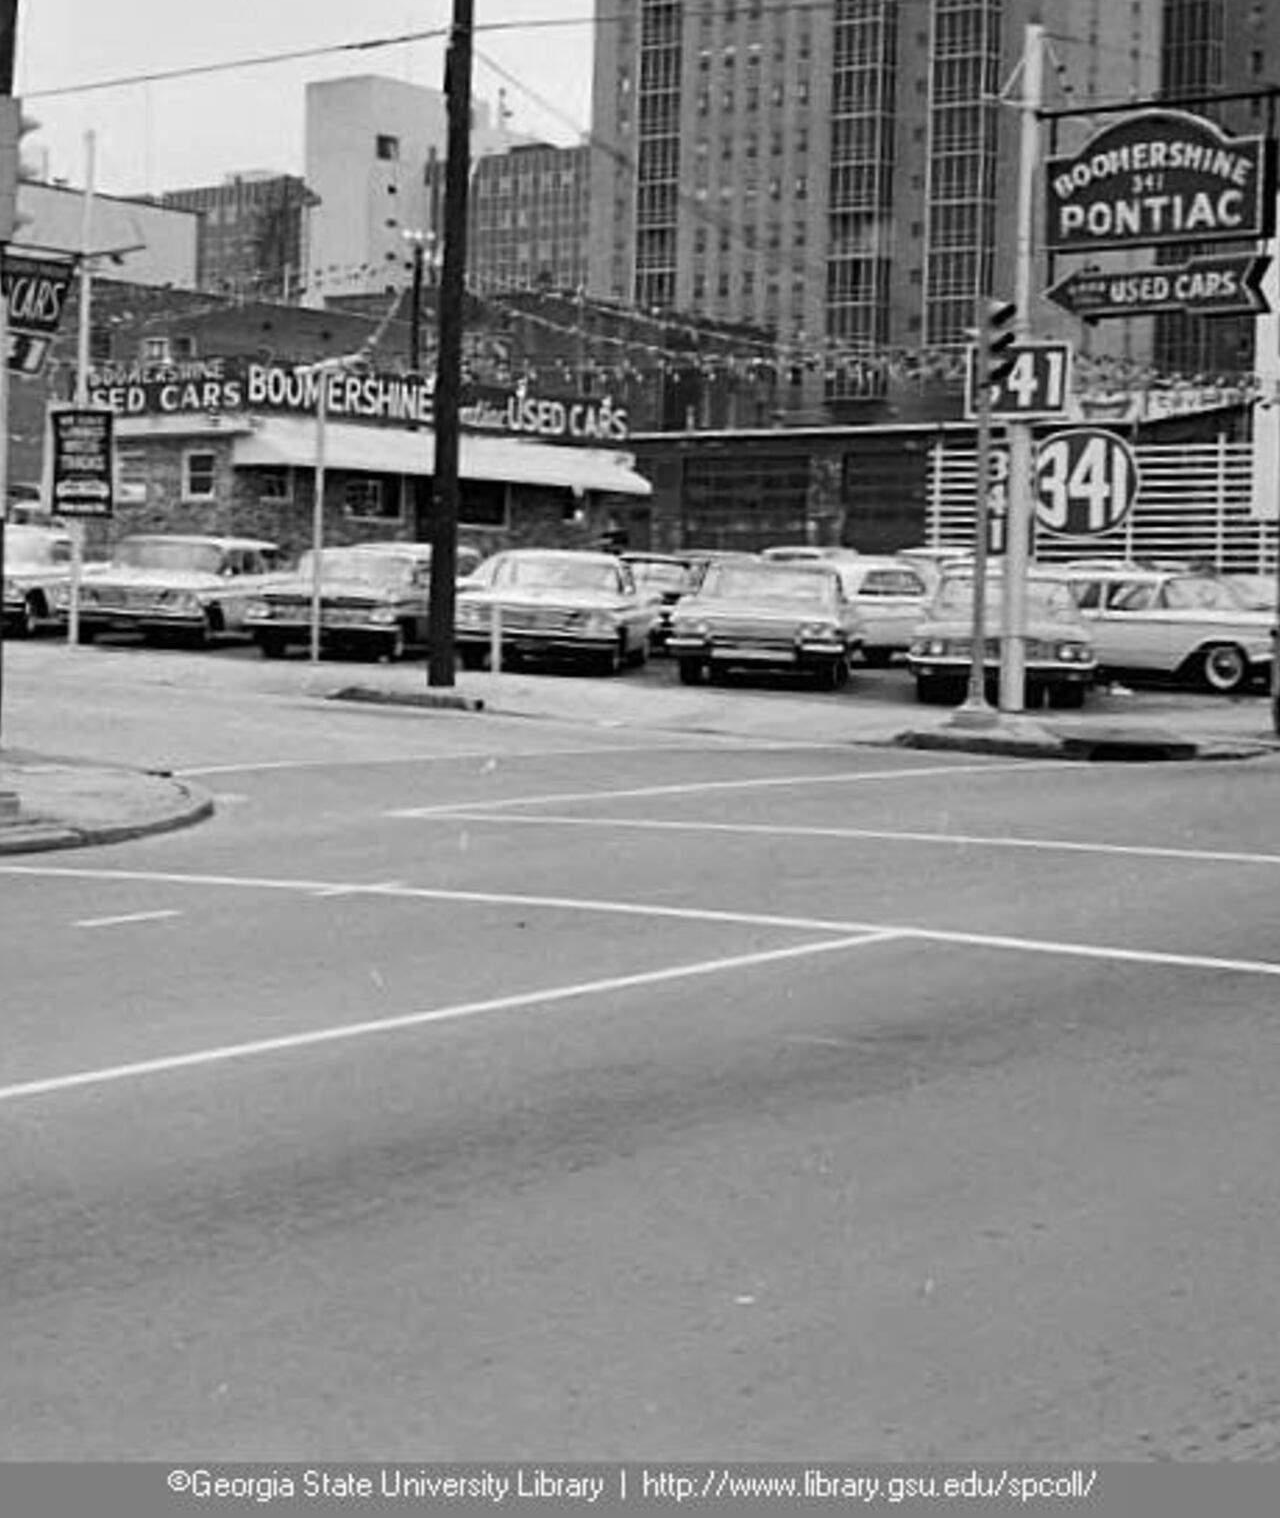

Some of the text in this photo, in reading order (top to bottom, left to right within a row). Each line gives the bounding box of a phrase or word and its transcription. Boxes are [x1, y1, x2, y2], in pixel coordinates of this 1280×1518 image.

[1053, 142, 1253, 198] BOOMERSHINE
[1060, 189, 1243, 238] PONTIAC
[1110, 276, 1168, 303] USED
[1175, 271, 1237, 299] CARS
[75, 381, 241, 414] SED CARS
[249, 363, 434, 422] BOOMERSHINE
[506, 394, 565, 434] USED
[570, 402, 628, 441] CARS
[990, 351, 1064, 407] 41
[1036, 437, 1128, 530] 341
